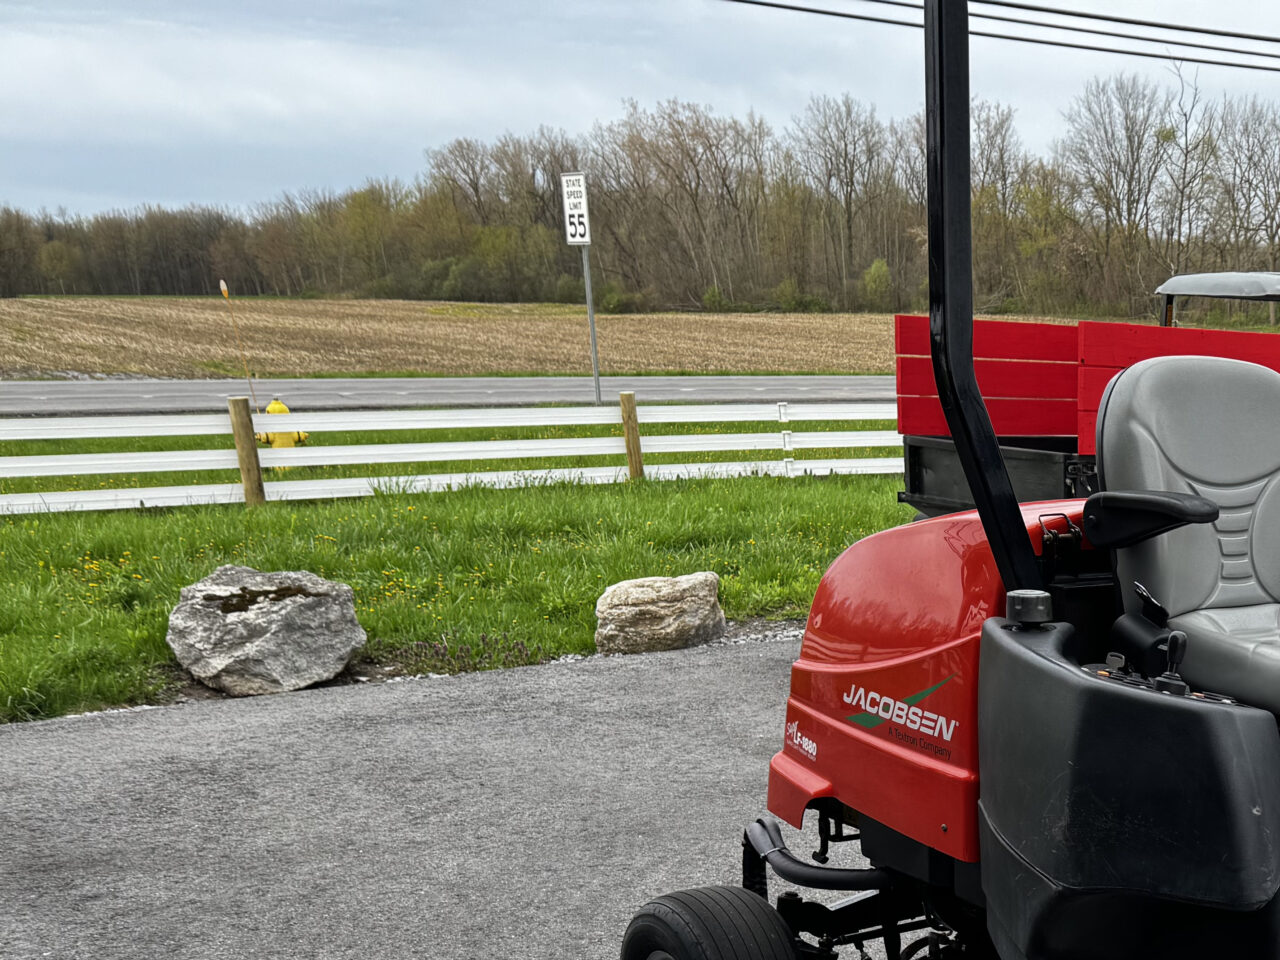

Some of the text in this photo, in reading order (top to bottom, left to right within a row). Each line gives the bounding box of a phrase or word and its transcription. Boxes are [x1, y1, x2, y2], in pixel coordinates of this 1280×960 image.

[565, 178, 582, 188] STATE
[566, 190, 583, 200] SPEED
[568, 202, 582, 211] LIMIT
[568, 213, 587, 239] 55
[842, 684, 956, 742] JACOBSEN
[895, 728, 918, 748] Textron
[919, 737, 952, 761] Company
